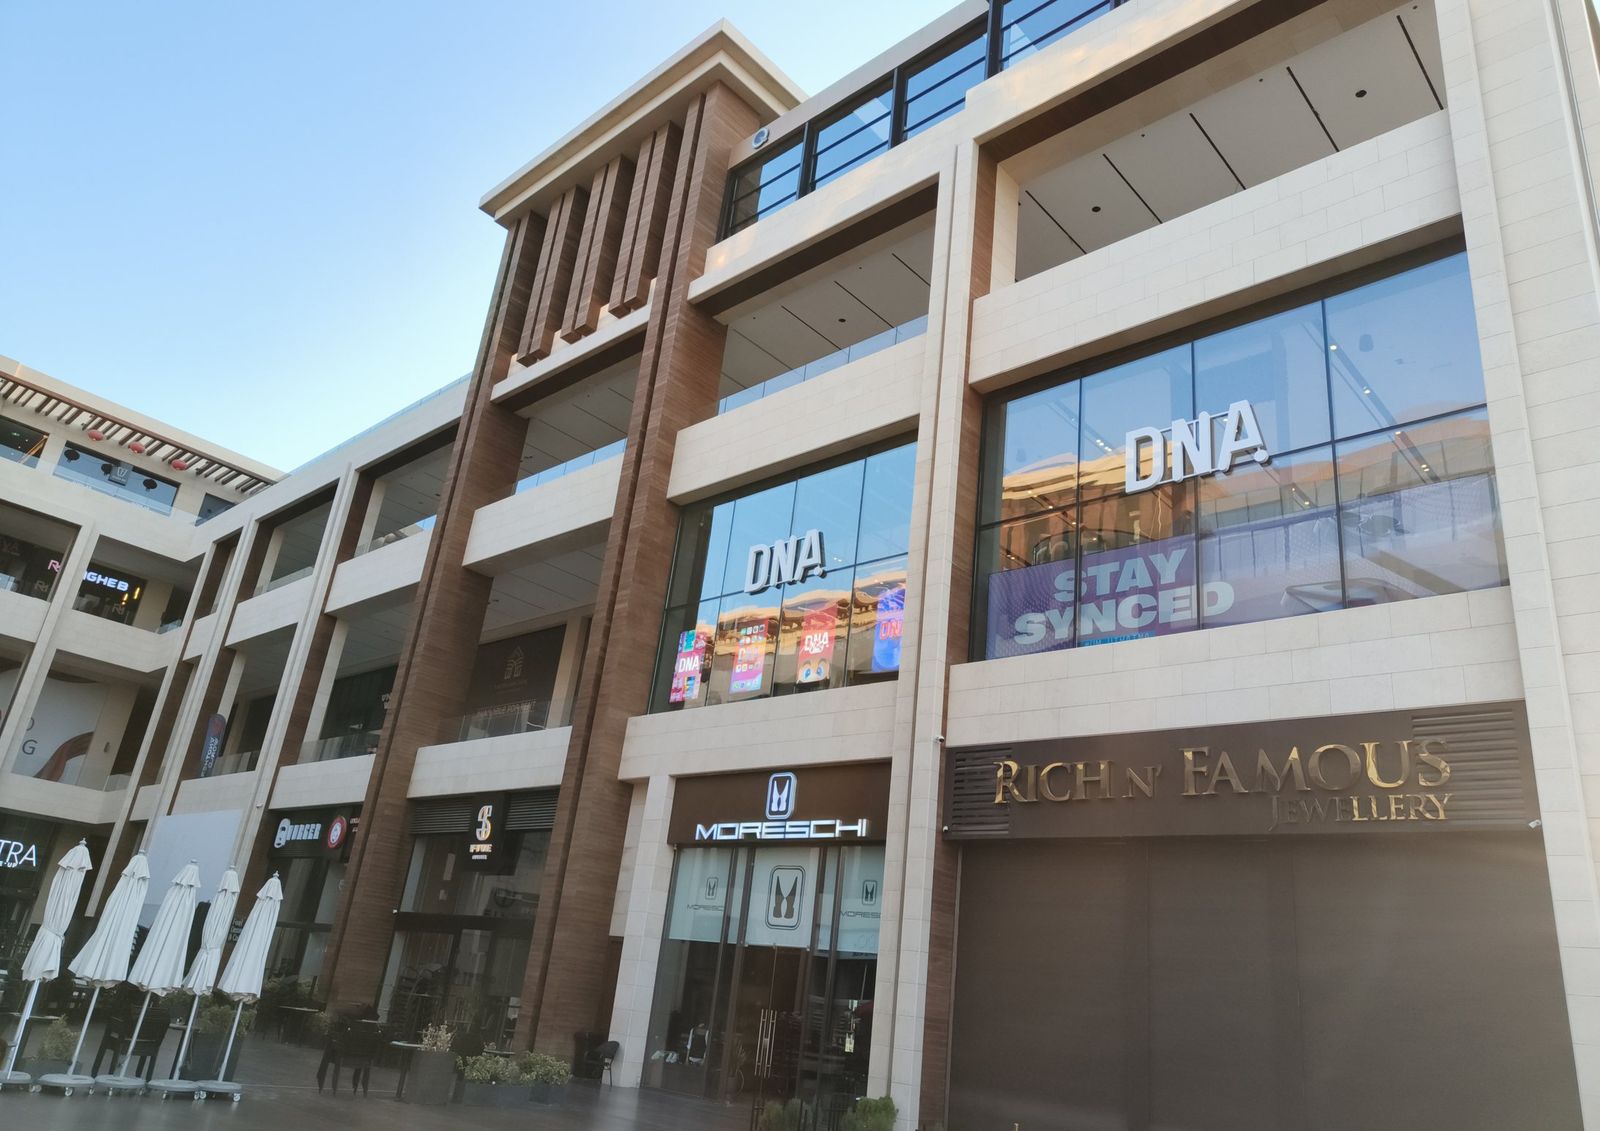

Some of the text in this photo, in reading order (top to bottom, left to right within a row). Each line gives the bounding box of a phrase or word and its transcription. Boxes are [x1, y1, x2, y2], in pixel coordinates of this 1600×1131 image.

[1054, 548, 1188, 602] STAY
[1014, 581, 1235, 646] SYNCED
[993, 760, 1114, 804] RICH
[1181, 740, 1452, 798] FAMOUS
[695, 819, 868, 841] MORESCHI
[1266, 792, 1453, 832] JEWELLERY
